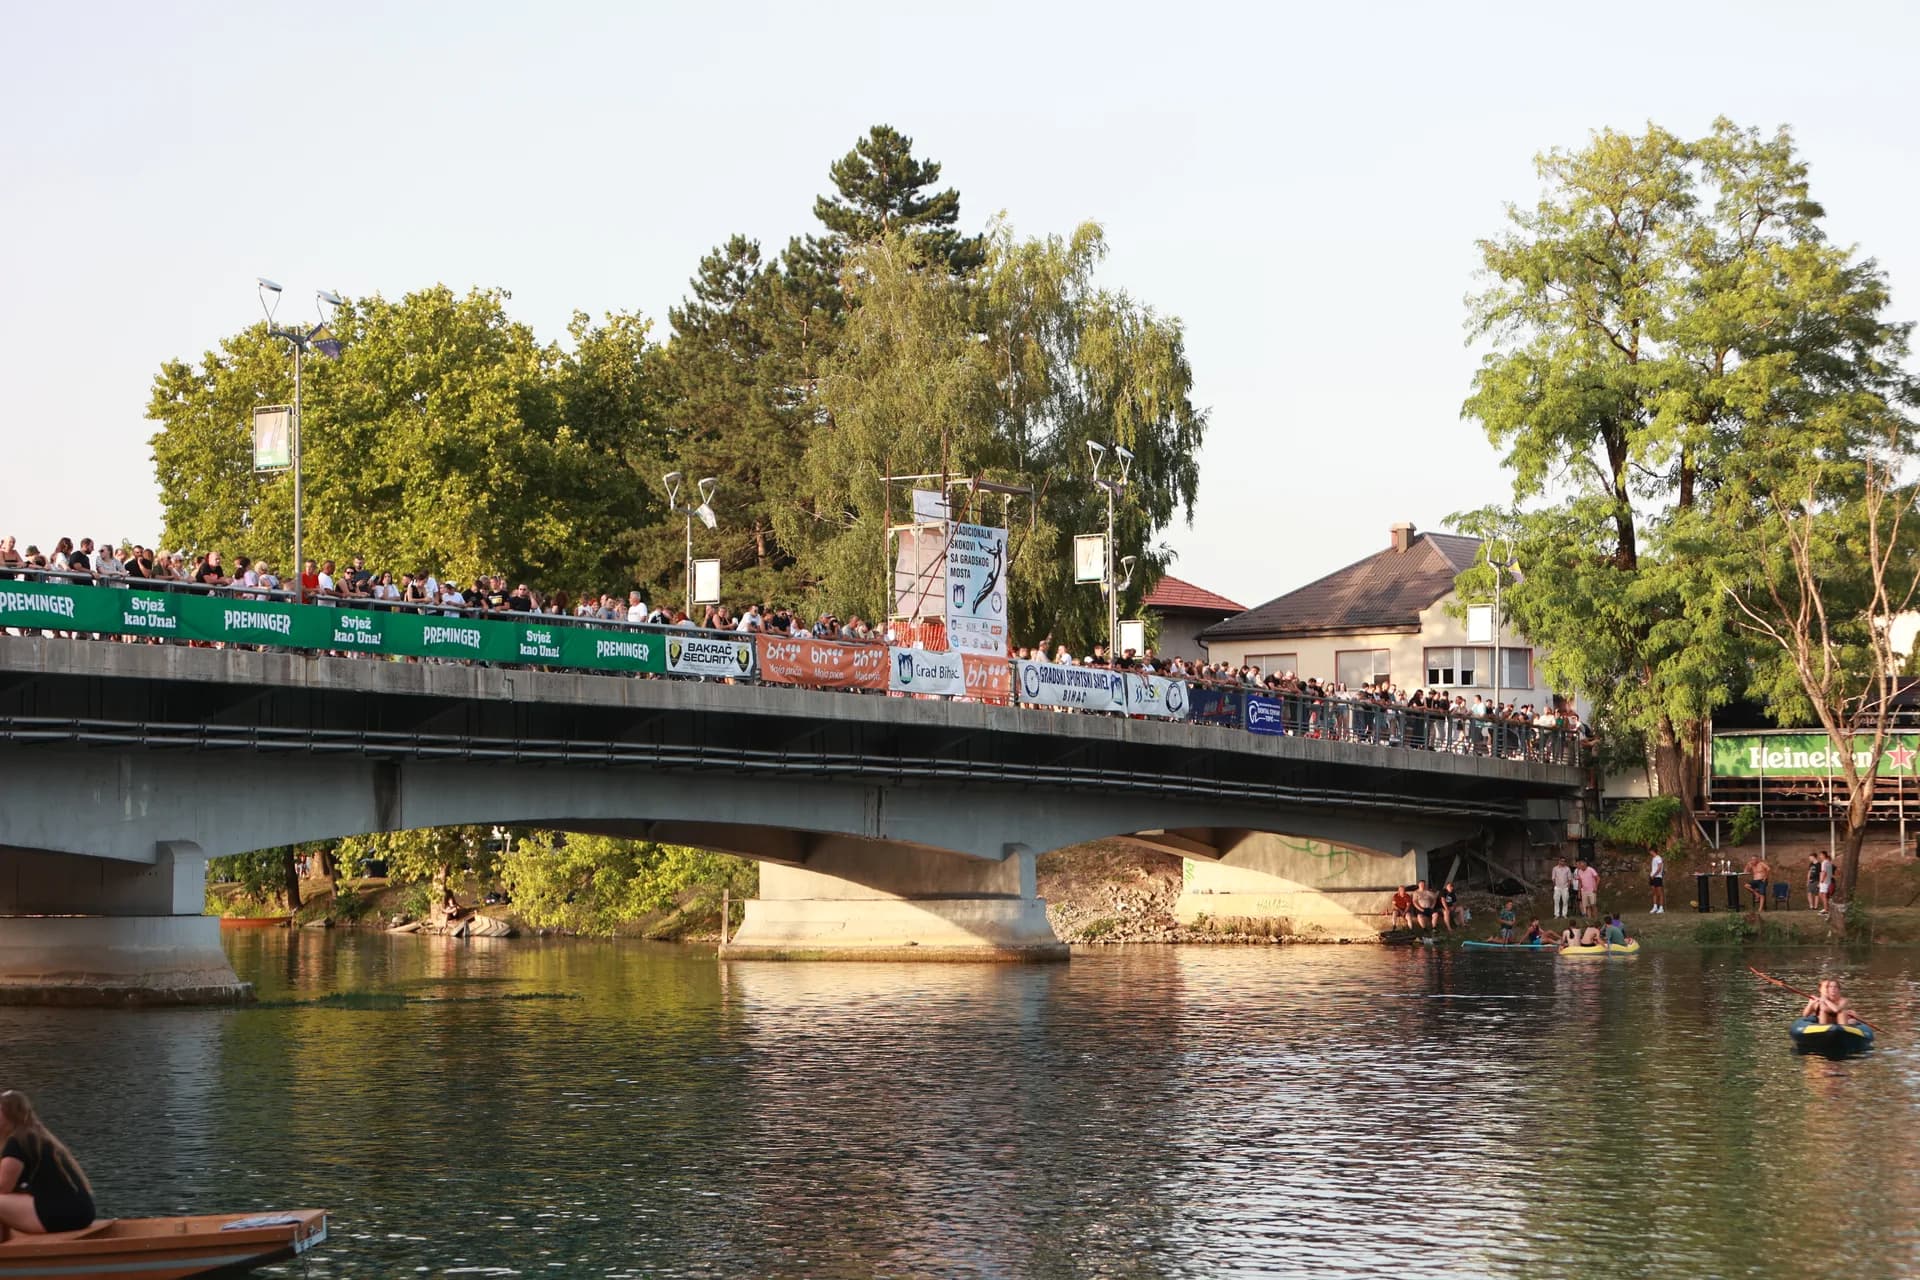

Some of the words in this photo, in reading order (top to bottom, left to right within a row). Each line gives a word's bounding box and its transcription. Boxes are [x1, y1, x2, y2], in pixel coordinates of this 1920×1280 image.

[950, 553, 958, 564] SA
[960, 554, 990, 568] GRADSKOG
[950, 568, 971, 579] MOSTA
[0, 592, 74, 618] PREMINGER
[131, 597, 165, 613] Svjež
[124, 612, 146, 626] kao
[147, 614, 177, 628] Una!
[224, 610, 291, 635] PREMINGER
[341, 616, 372, 630] Svjež
[334, 629, 355, 643] kao
[357, 632, 382, 645] Una!
[423, 626, 481, 648] PREMINGER
[526, 630, 551, 644] Svjež
[520, 643, 538, 656] kao
[539, 646, 560, 658] Una!
[596, 640, 649, 662] PREMINGER
[688, 643, 732, 655] BAKRAČ
[683, 653, 734, 664] SECURITY
[916, 663, 937, 678] Grad
[1040, 666, 1066, 685] GRADSKI
[1066, 669, 1093, 689] SPORTSKI
